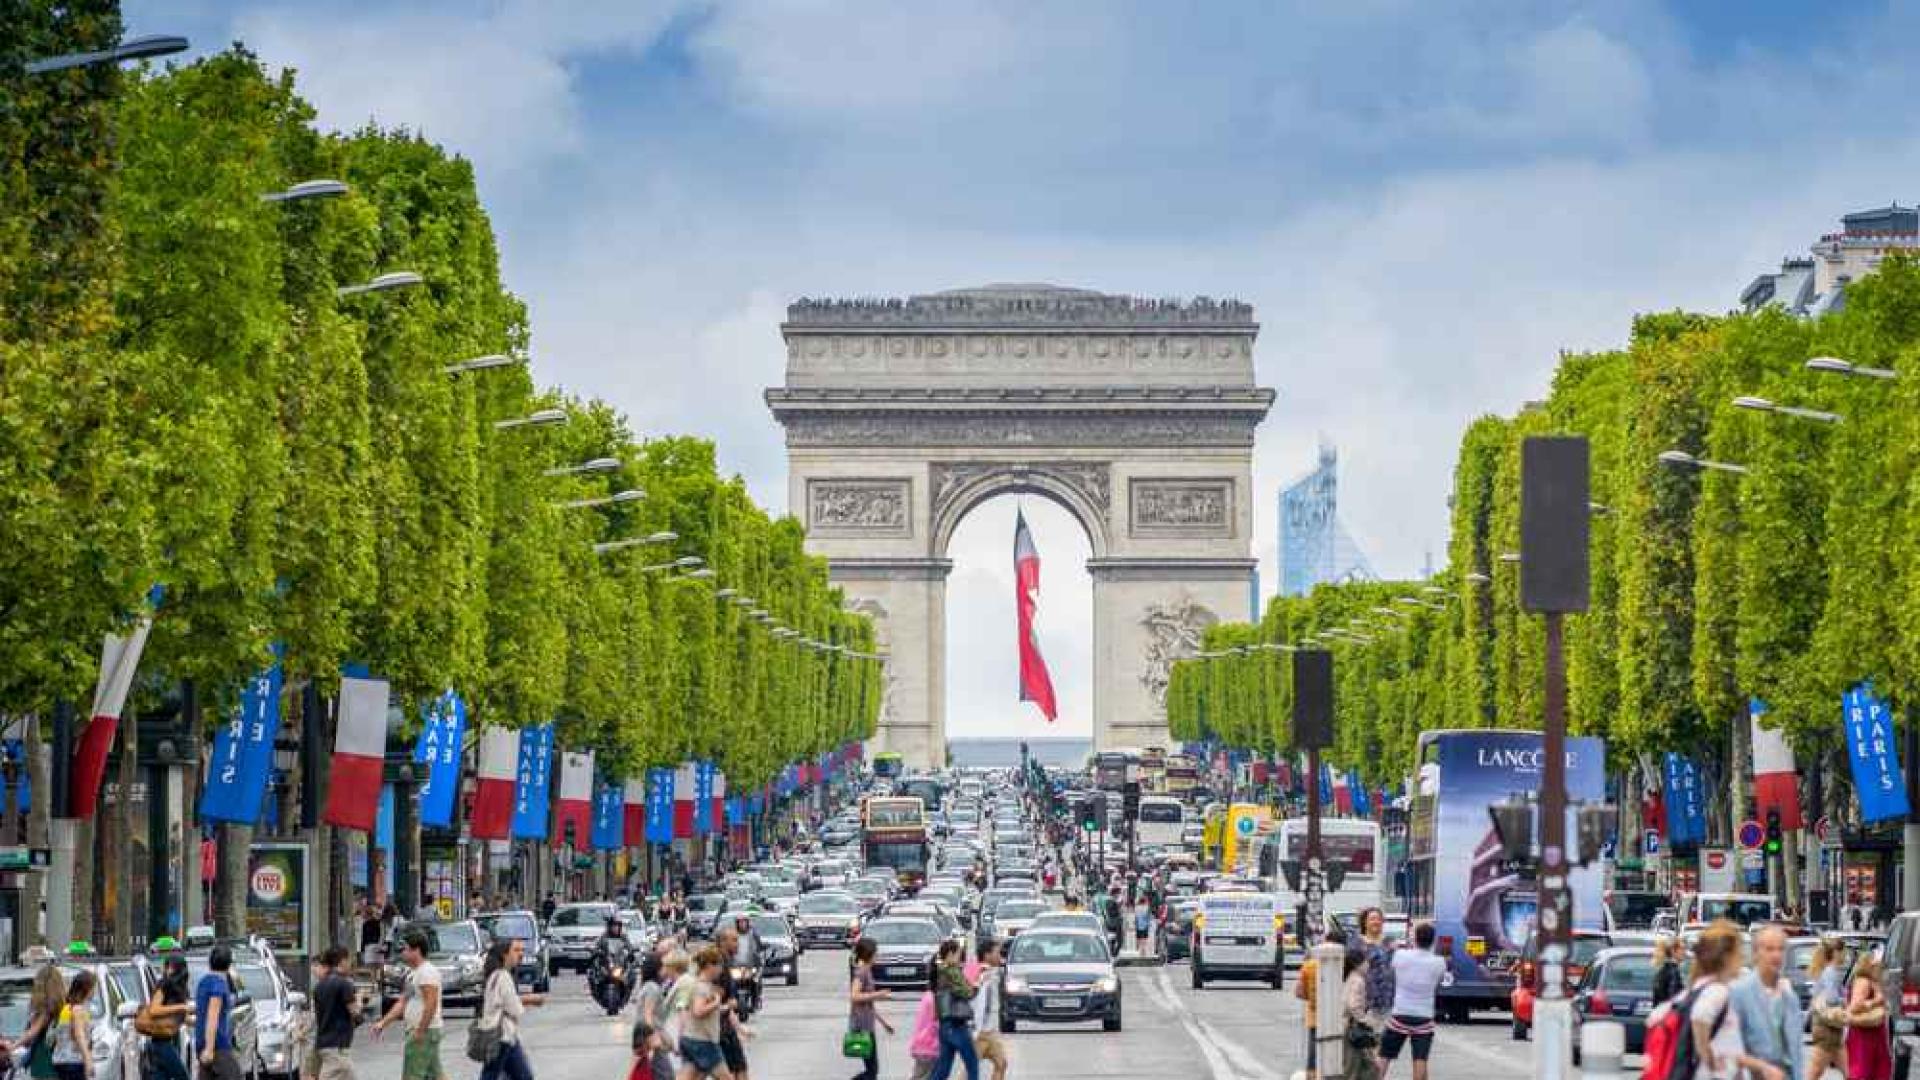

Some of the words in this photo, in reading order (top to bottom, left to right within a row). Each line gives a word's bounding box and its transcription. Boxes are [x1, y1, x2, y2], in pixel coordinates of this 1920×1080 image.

[1851, 690, 1869, 757] IRIE
[1870, 705, 1893, 789] PARIS
[1683, 757, 1697, 817] ARIS
